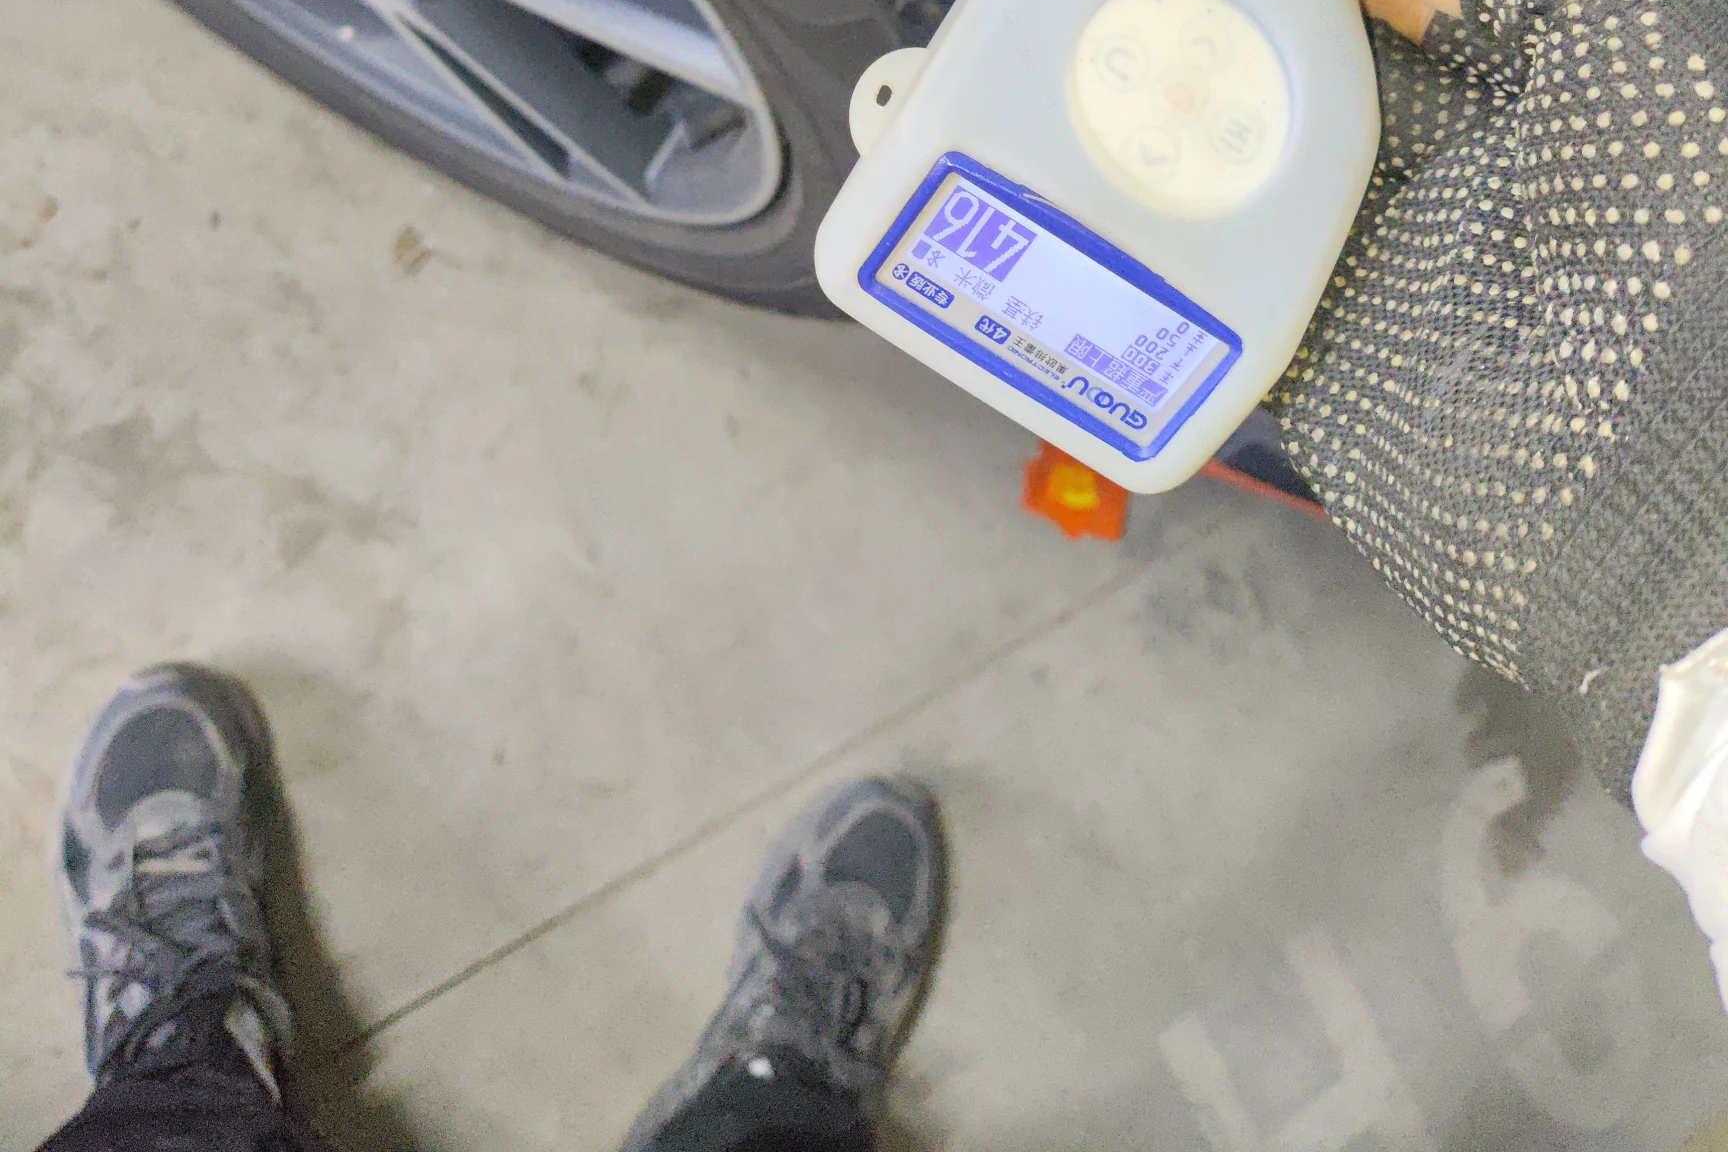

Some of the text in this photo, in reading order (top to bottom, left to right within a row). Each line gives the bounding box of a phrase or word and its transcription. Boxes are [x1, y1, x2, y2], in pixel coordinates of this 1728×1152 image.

[927, 186, 1034, 280] 416
[907, 272, 952, 307] 专业版
[950, 264, 995, 302] 微米
[977, 316, 1009, 343] 4代
[999, 294, 1045, 333] 铁基
[1175, 320, 1190, 335] 0
[1012, 335, 1069, 375] 果欧排雷王
[1133, 333, 1169, 361] 200
[1154, 326, 1181, 347] 50
[1006, 344, 1060, 381] ELECTRONIC
[1065, 334, 1167, 406] 严重超上限
[1122, 346, 1159, 374] 300
[1066, 372, 1150, 433] GUOOU
